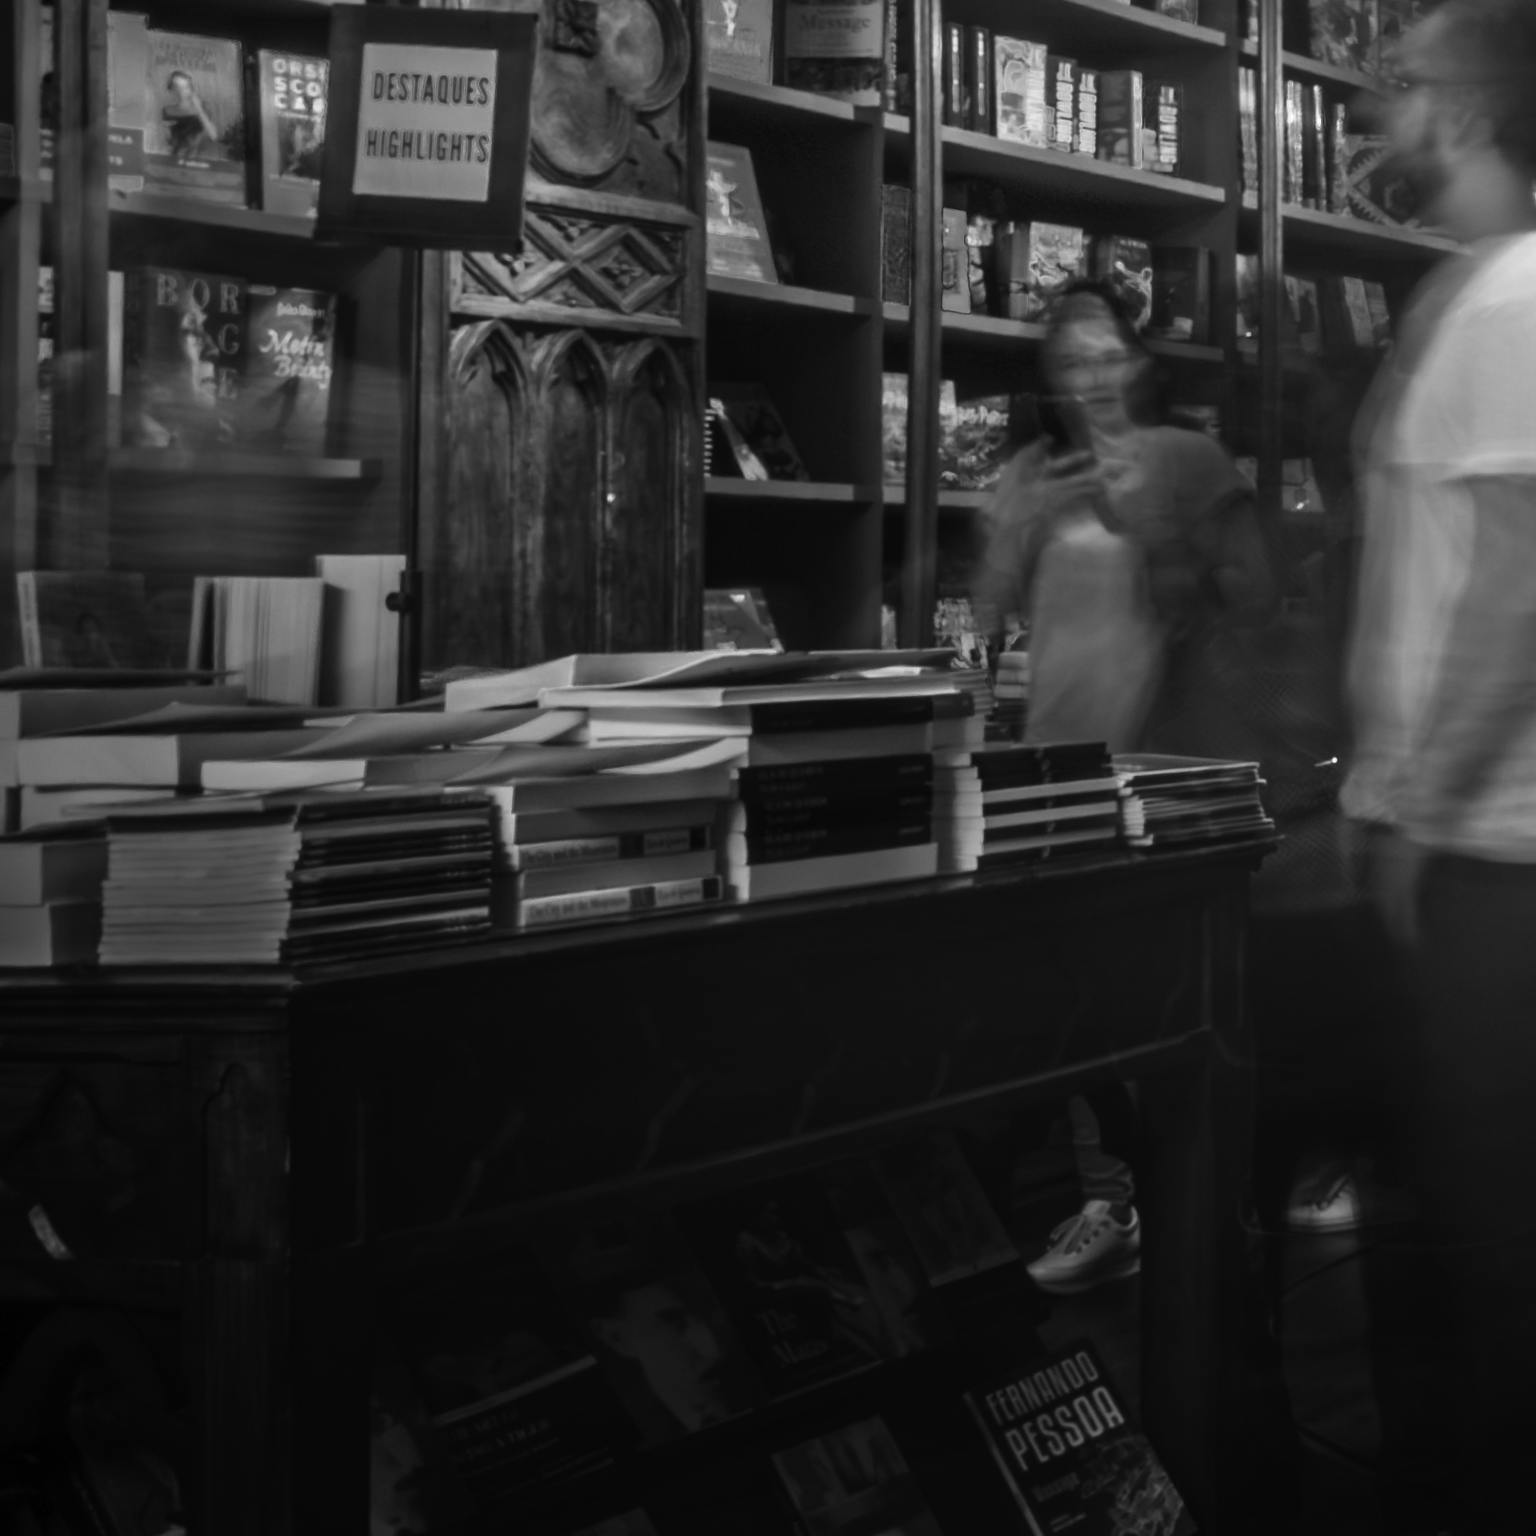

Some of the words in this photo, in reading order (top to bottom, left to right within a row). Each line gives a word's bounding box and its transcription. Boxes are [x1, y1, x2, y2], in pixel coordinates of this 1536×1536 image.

[373, 71, 489, 107] DESTAQUES
[366, 130, 489, 164] HIGHLIGHTS
[985, 1350, 1099, 1426] FERNANDO
[1004, 1385, 1125, 1472] PESSOA
